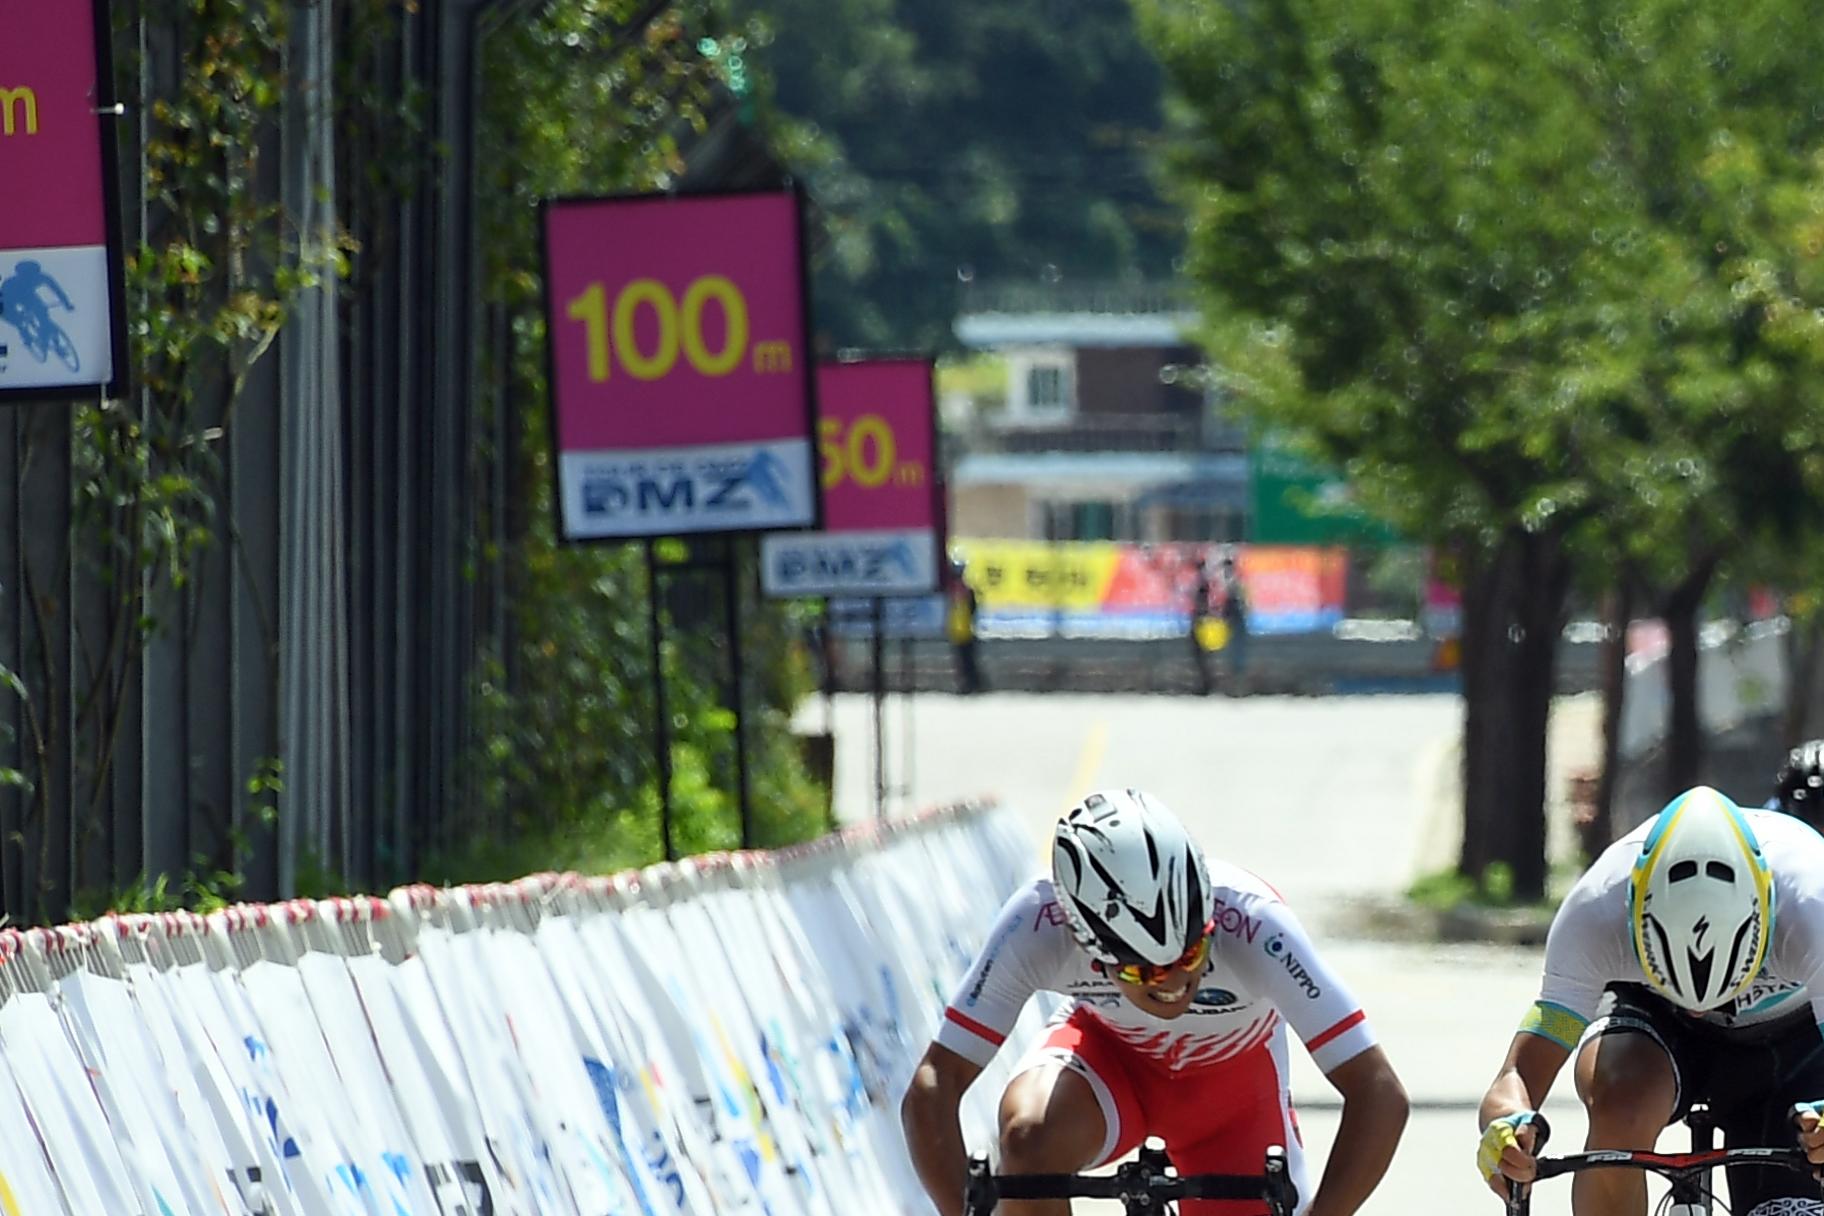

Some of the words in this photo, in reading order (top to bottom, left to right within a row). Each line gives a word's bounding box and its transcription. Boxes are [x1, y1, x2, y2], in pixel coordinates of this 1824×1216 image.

[567, 274, 748, 384] 100
[753, 340, 793, 375] m
[582, 470, 753, 515] DMZ
[1280, 951, 1321, 1000] NIPPO
